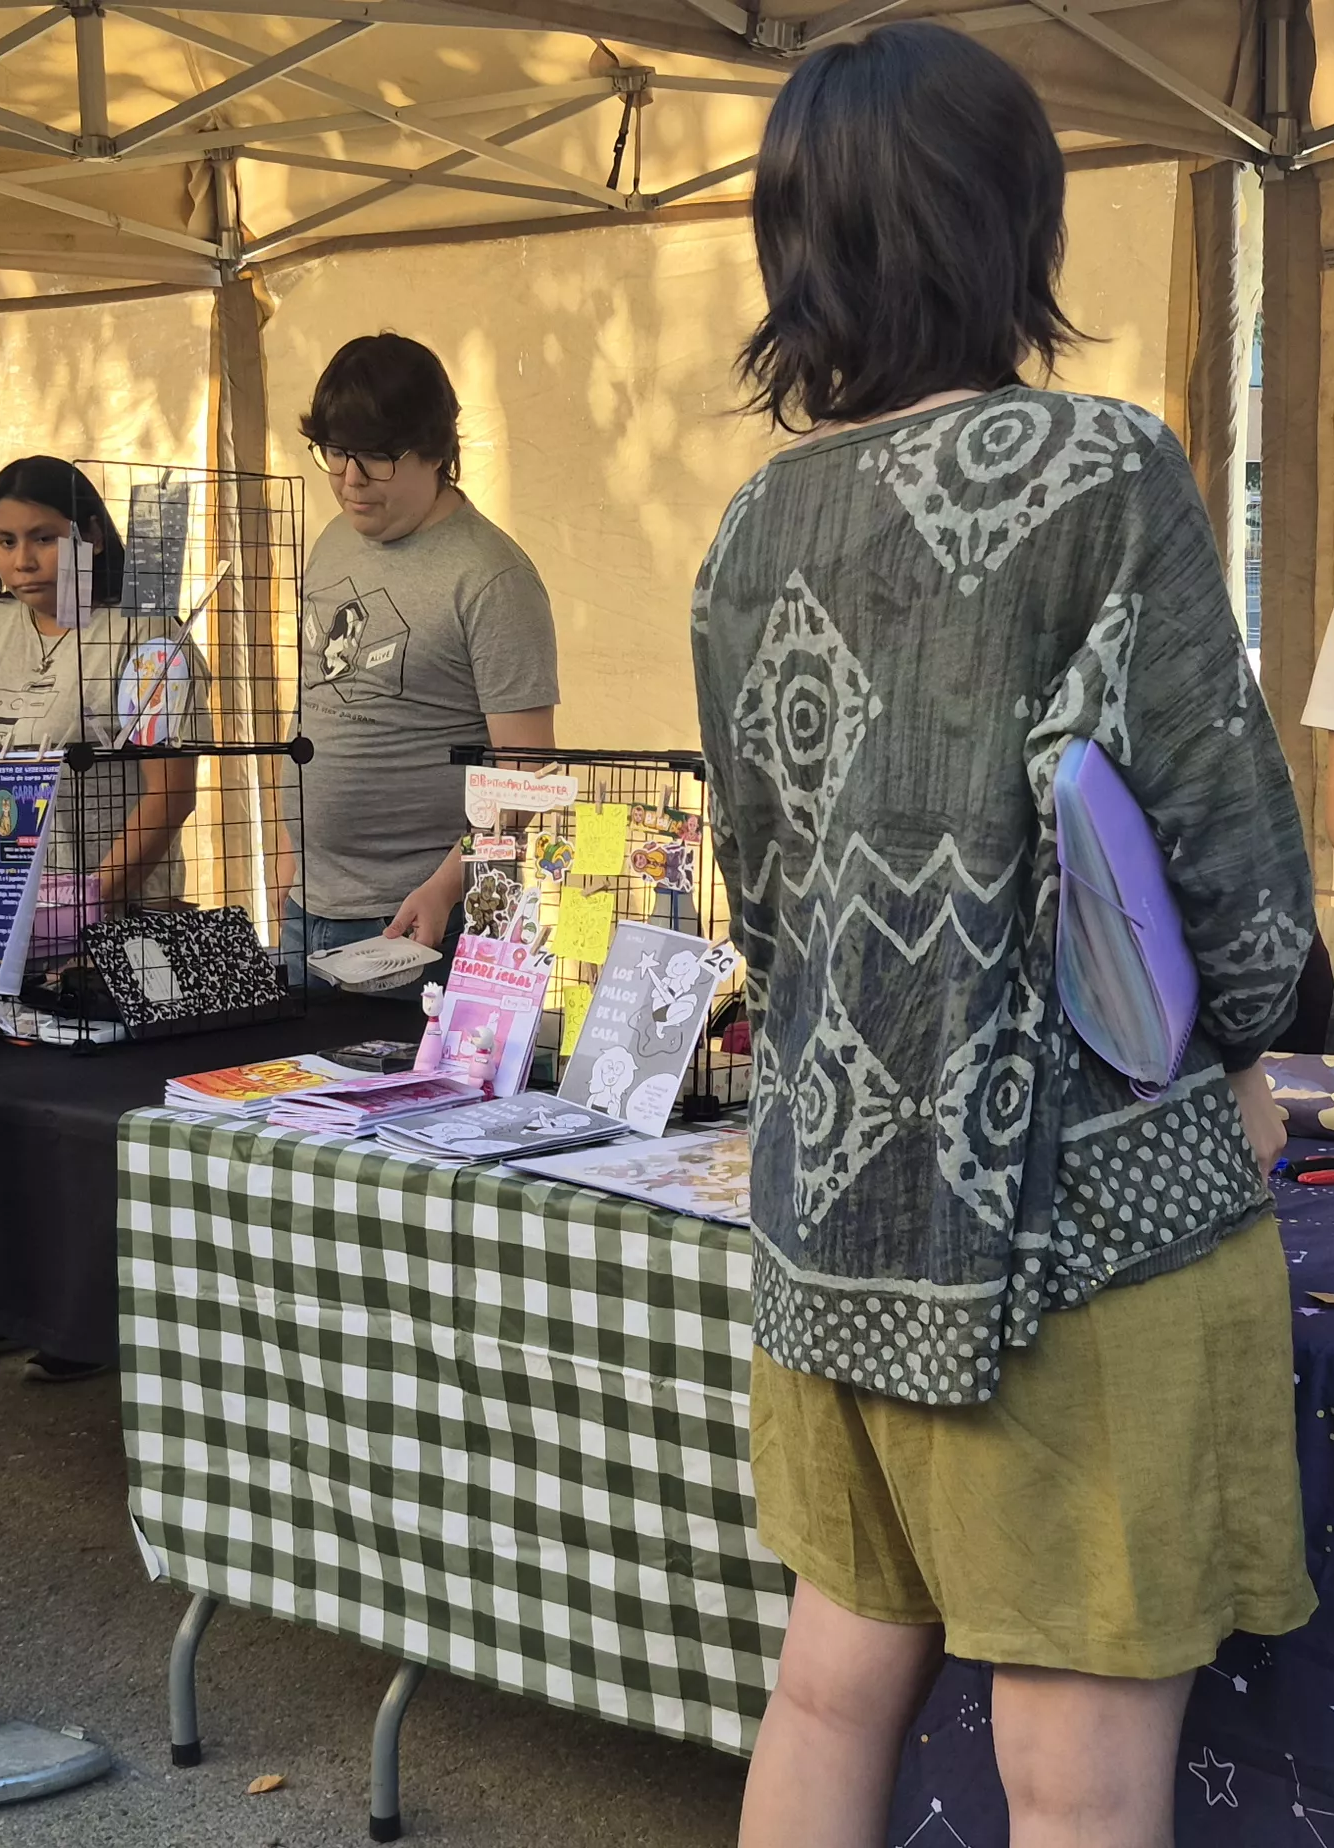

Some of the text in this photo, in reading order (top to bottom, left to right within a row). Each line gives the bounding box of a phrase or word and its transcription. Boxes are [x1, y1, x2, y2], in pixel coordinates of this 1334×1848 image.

[612, 966, 634, 982] LOS
[600, 986, 638, 1003] PILLOS
[596, 1005, 628, 1024] DE LA
[591, 1026, 620, 1042] CASA
